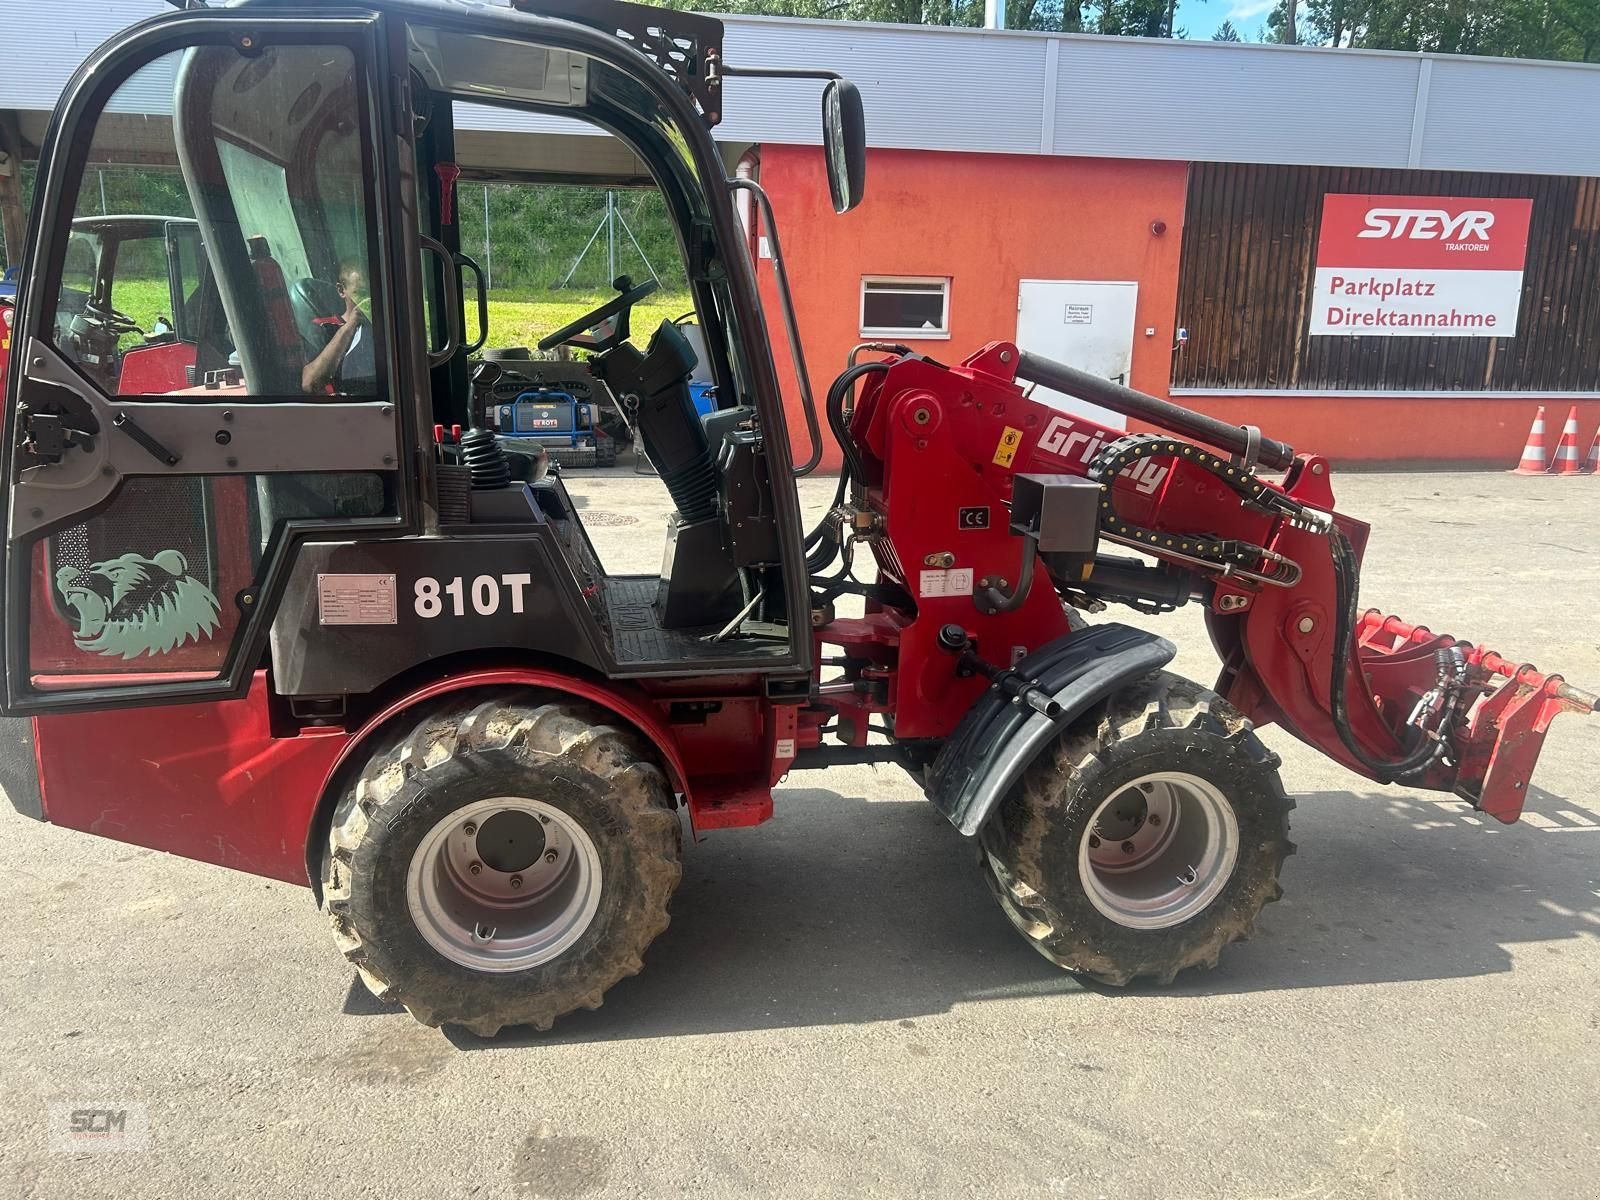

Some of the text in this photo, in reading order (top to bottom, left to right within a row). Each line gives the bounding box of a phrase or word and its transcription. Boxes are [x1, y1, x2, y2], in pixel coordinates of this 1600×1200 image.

[1357, 208, 1495, 240] STEYR
[1445, 243, 1490, 252] TRAKTOREN
[1330, 276, 1435, 301] Parkplatz
[1327, 307, 1496, 327] Direktannahme
[1037, 416, 1169, 495] Grily
[966, 511, 983, 525] CE
[414, 573, 531, 618] 810T
